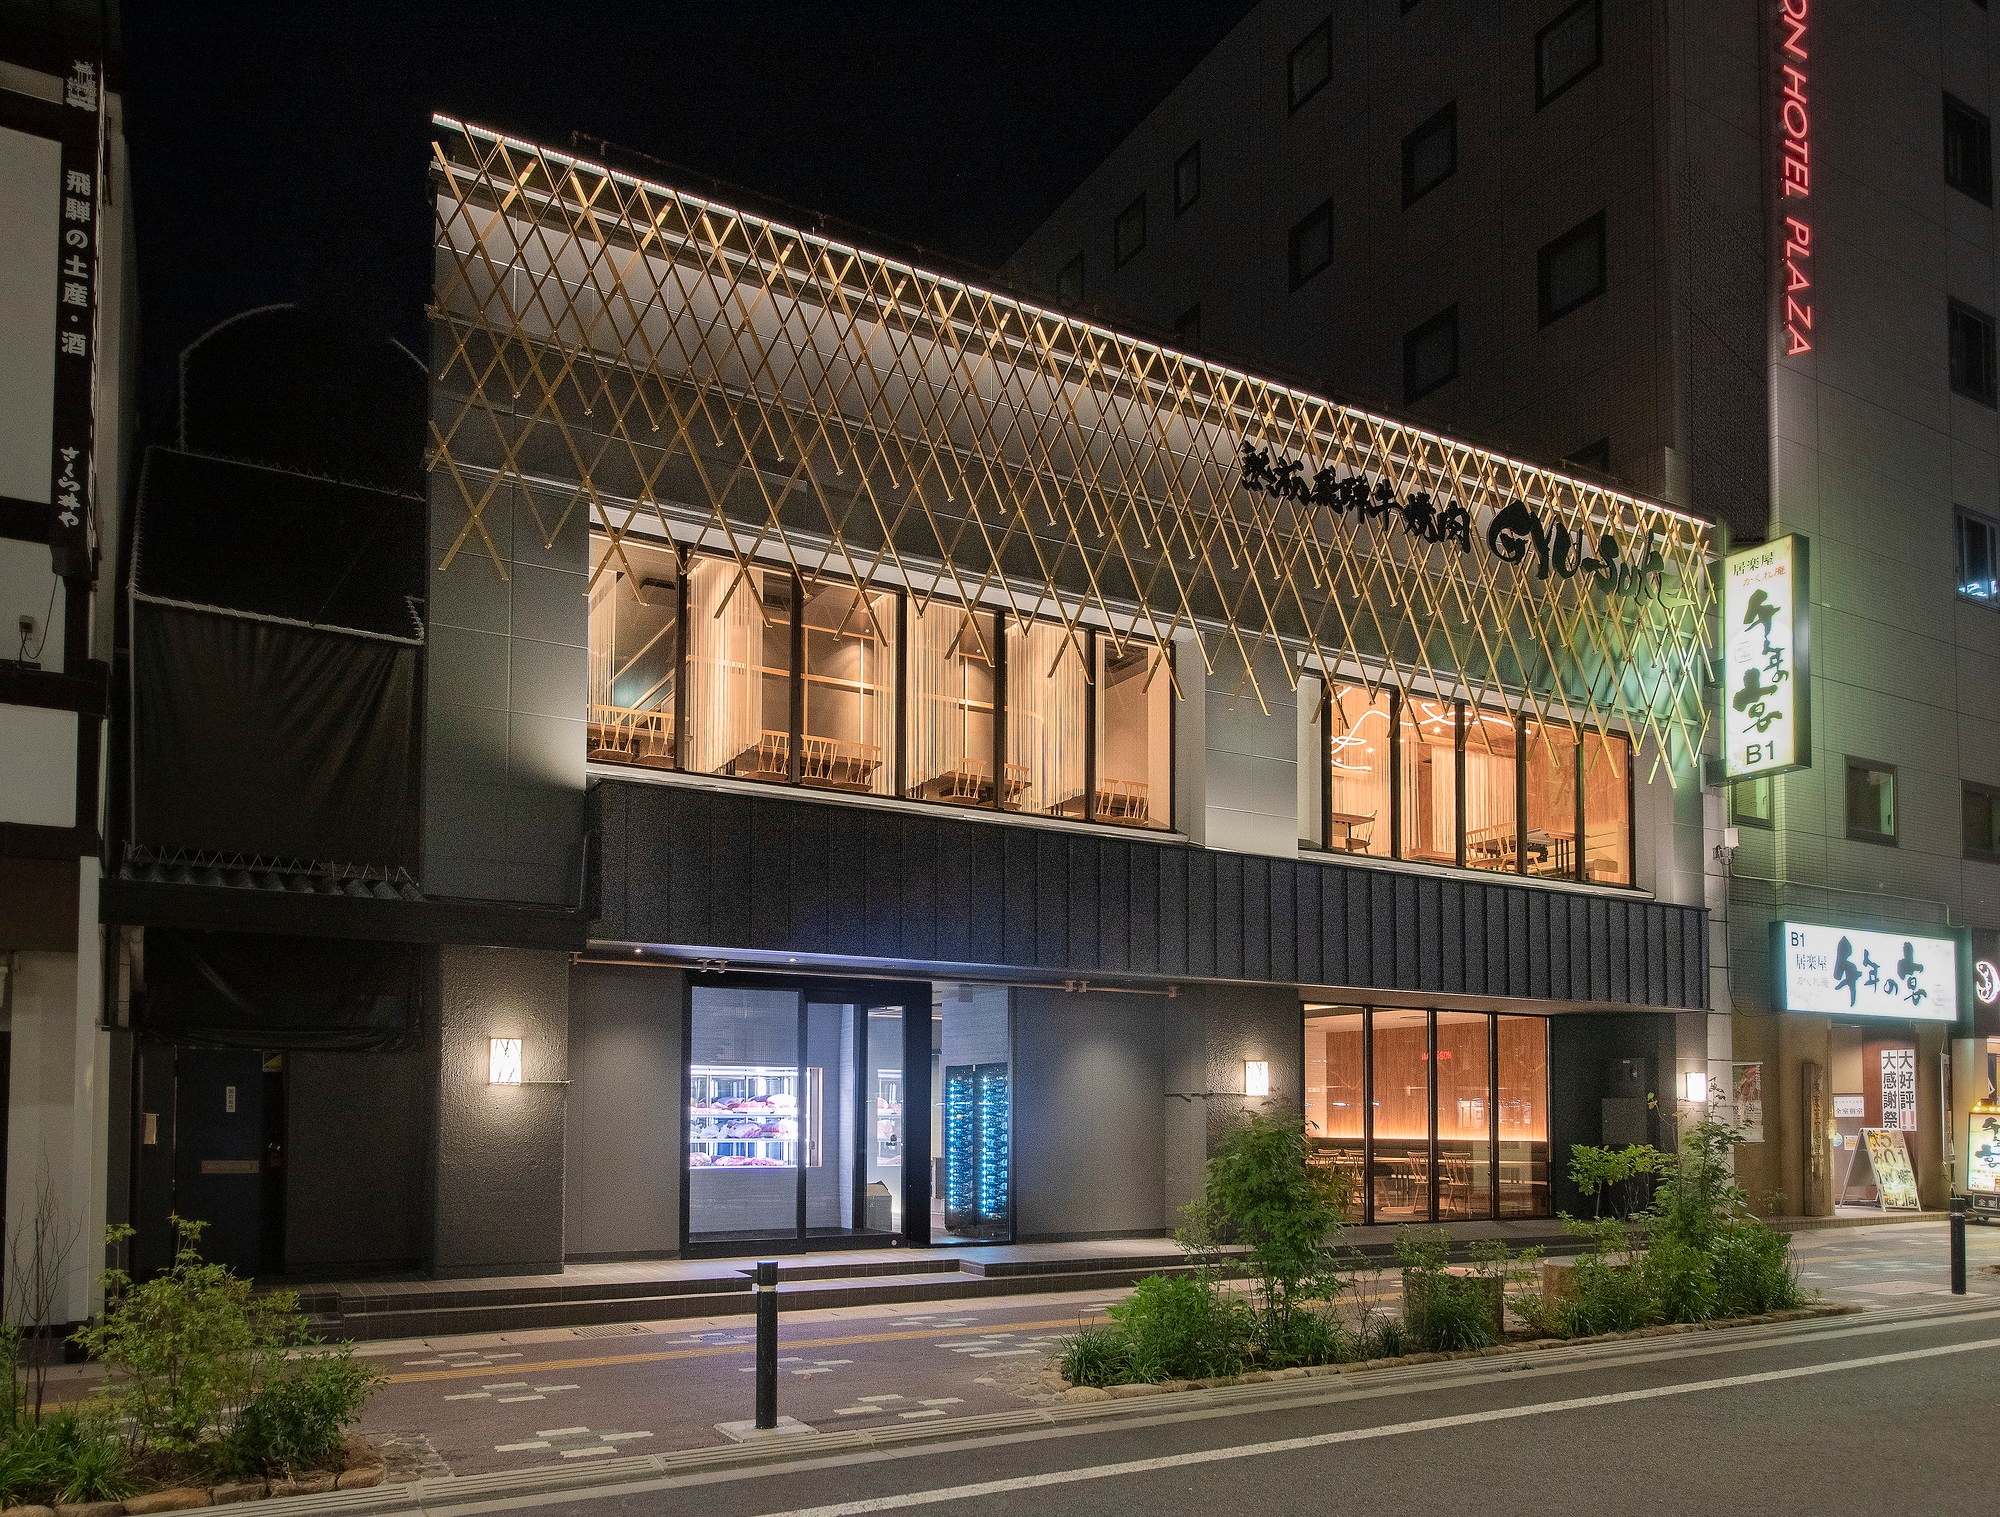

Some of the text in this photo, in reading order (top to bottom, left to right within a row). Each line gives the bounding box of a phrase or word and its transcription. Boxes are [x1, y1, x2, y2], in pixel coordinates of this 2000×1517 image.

[1783, 64, 1809, 196] HOTEL
[62, 170, 91, 357] 飛騨の土産・酒
[1786, 216, 1813, 356] PLAZA
[1733, 551, 1776, 577] 居楽屋
[1746, 740, 1776, 766] B1
[1791, 932, 1806, 947] B1
[1796, 953, 1828, 971] 居楽屋
[1882, 1051, 1898, 1129] 大感謝祭
